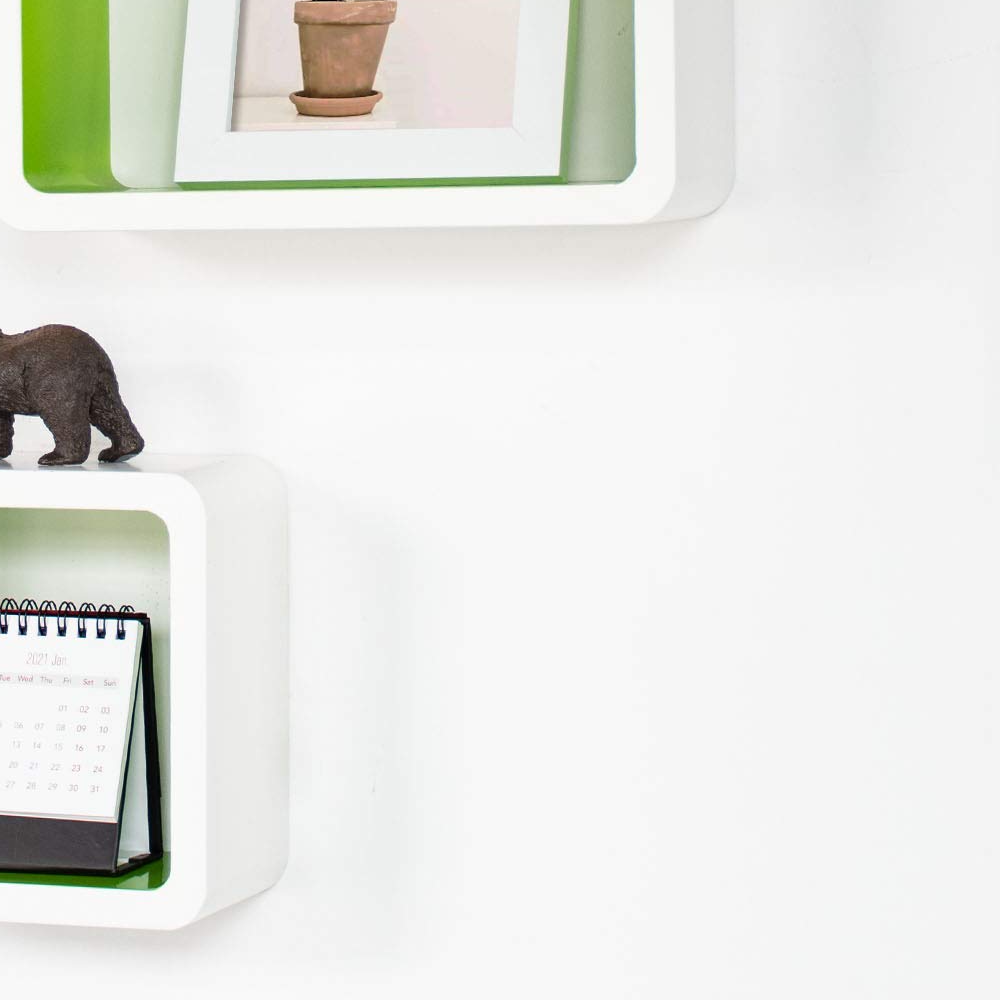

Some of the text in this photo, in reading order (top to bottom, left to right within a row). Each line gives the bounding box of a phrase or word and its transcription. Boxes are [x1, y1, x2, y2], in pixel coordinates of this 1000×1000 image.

[25, 652, 48, 666] 2021
[0, 673, 11, 682] Tue
[17, 674, 34, 683] Wed
[39, 675, 53, 684] Thu
[62, 676, 72, 685] Fri
[82, 678, 94, 686] Sat
[103, 679, 117, 687] Sun
[57, 704, 68, 713] 01
[79, 705, 90, 714] 02
[33, 722, 45, 731] 07
[76, 724, 87, 733] 09
[99, 725, 109, 734] 10
[32, 741, 42, 750] 14
[53, 742, 65, 752] 15
[75, 743, 85, 752] 16
[95, 744, 106, 753] 17
[28, 761, 39, 771] 21
[49, 762, 61, 772] 22
[71, 763, 81, 773] 23
[92, 765, 103, 774] 24
[4, 779, 16, 789] 27
[47, 782, 59, 791] 29
[67, 783, 79, 793] 30
[89, 784, 100, 793] 31
